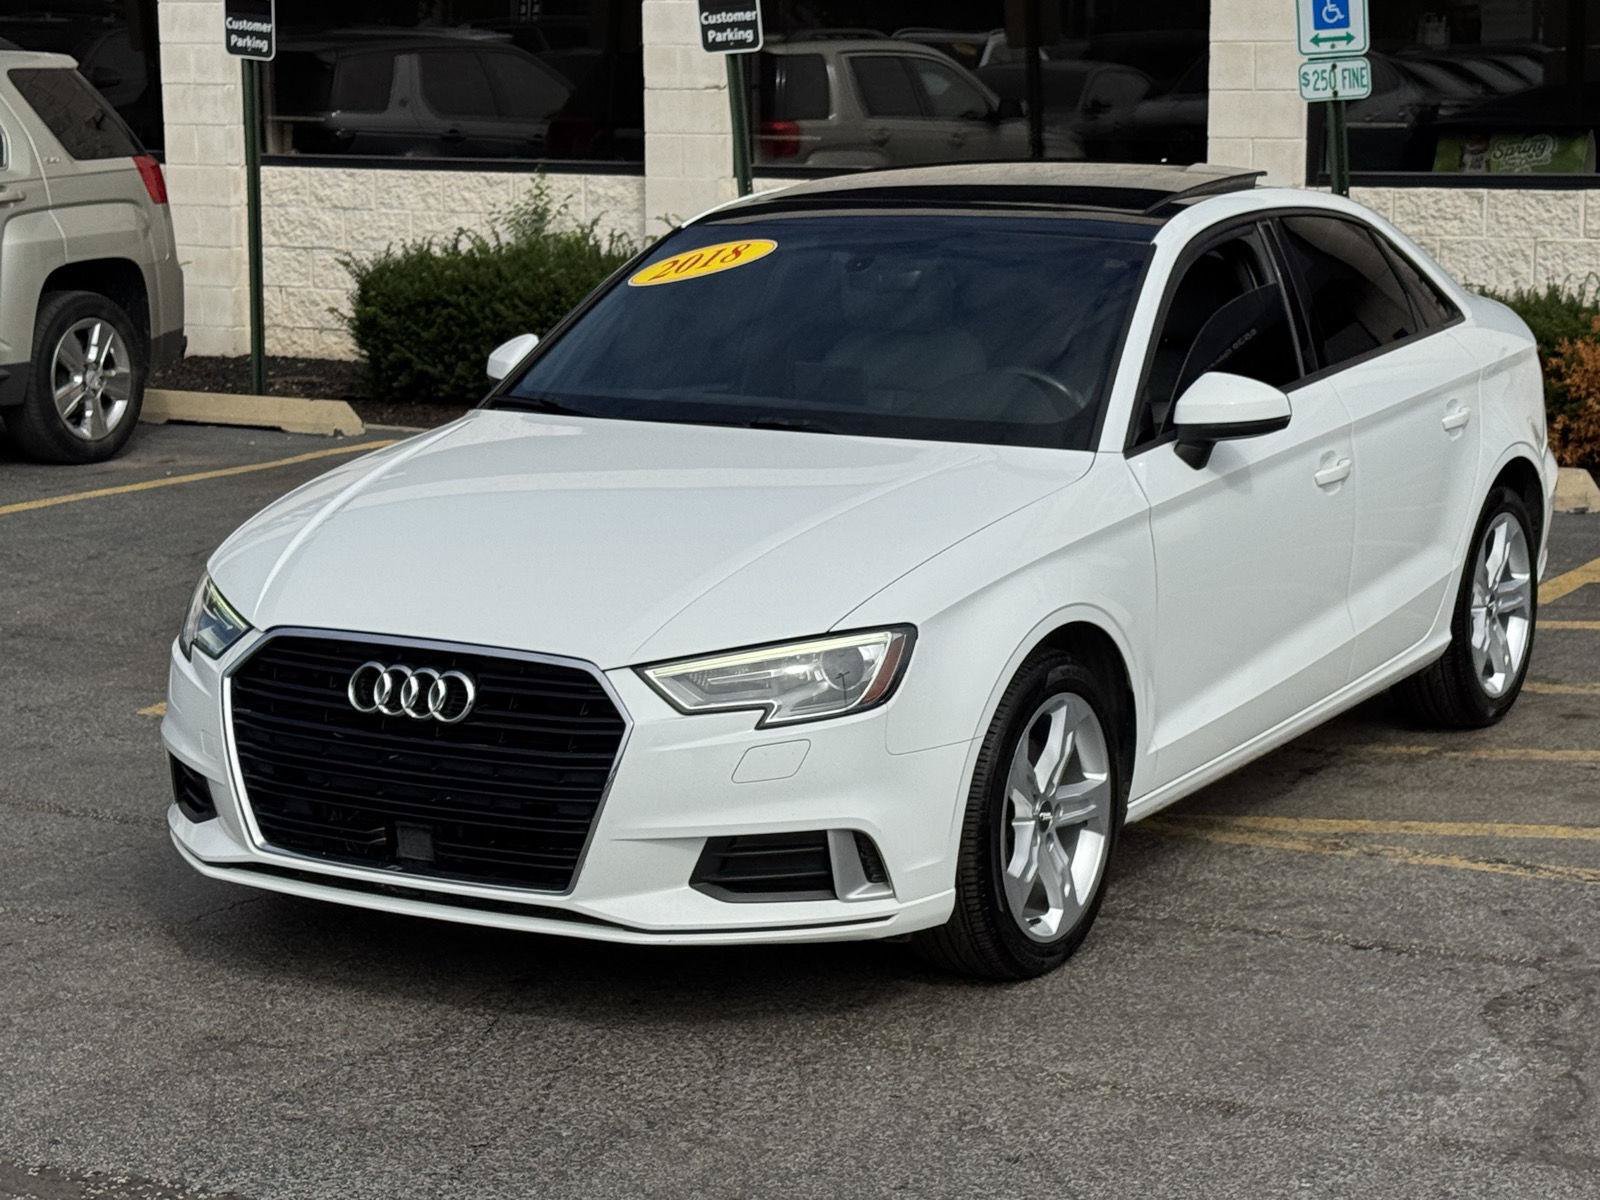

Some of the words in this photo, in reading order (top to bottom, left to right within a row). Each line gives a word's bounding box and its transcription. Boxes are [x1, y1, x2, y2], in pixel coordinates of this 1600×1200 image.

[226, 17, 272, 33] Customer
[701, 11, 757, 25] Customer
[230, 34, 268, 52] Parking
[708, 28, 754, 43] Parking
[1341, 67, 1368, 89] FINE
[648, 243, 752, 281] 2018
